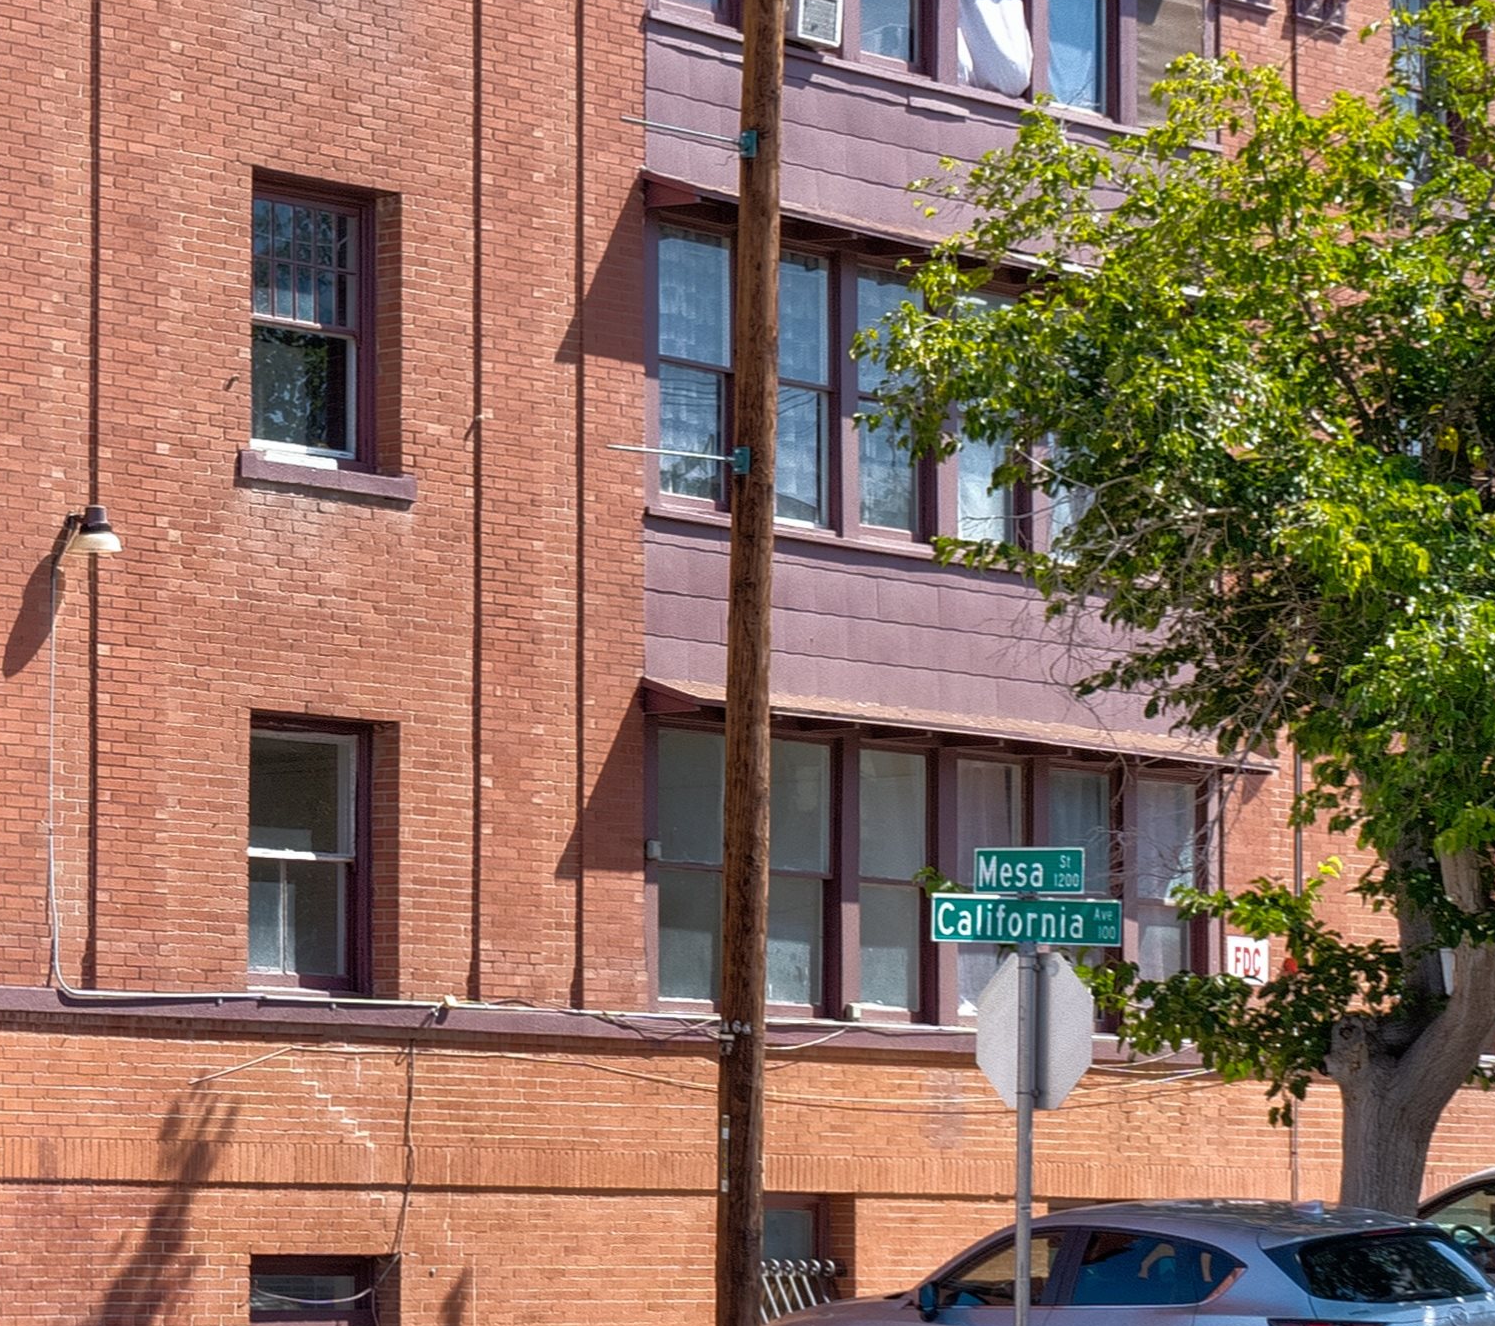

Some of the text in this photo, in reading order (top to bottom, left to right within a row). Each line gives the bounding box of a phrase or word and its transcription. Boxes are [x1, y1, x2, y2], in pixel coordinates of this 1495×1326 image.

[1059, 855, 1071, 869] St
[978, 855, 1044, 887] Mesa
[1053, 873, 1080, 887] 1200
[937, 902, 1084, 939] California
[1093, 908, 1113, 921] Ave
[1098, 926, 1117, 939] 100
[1235, 946, 1261, 977] FDC
